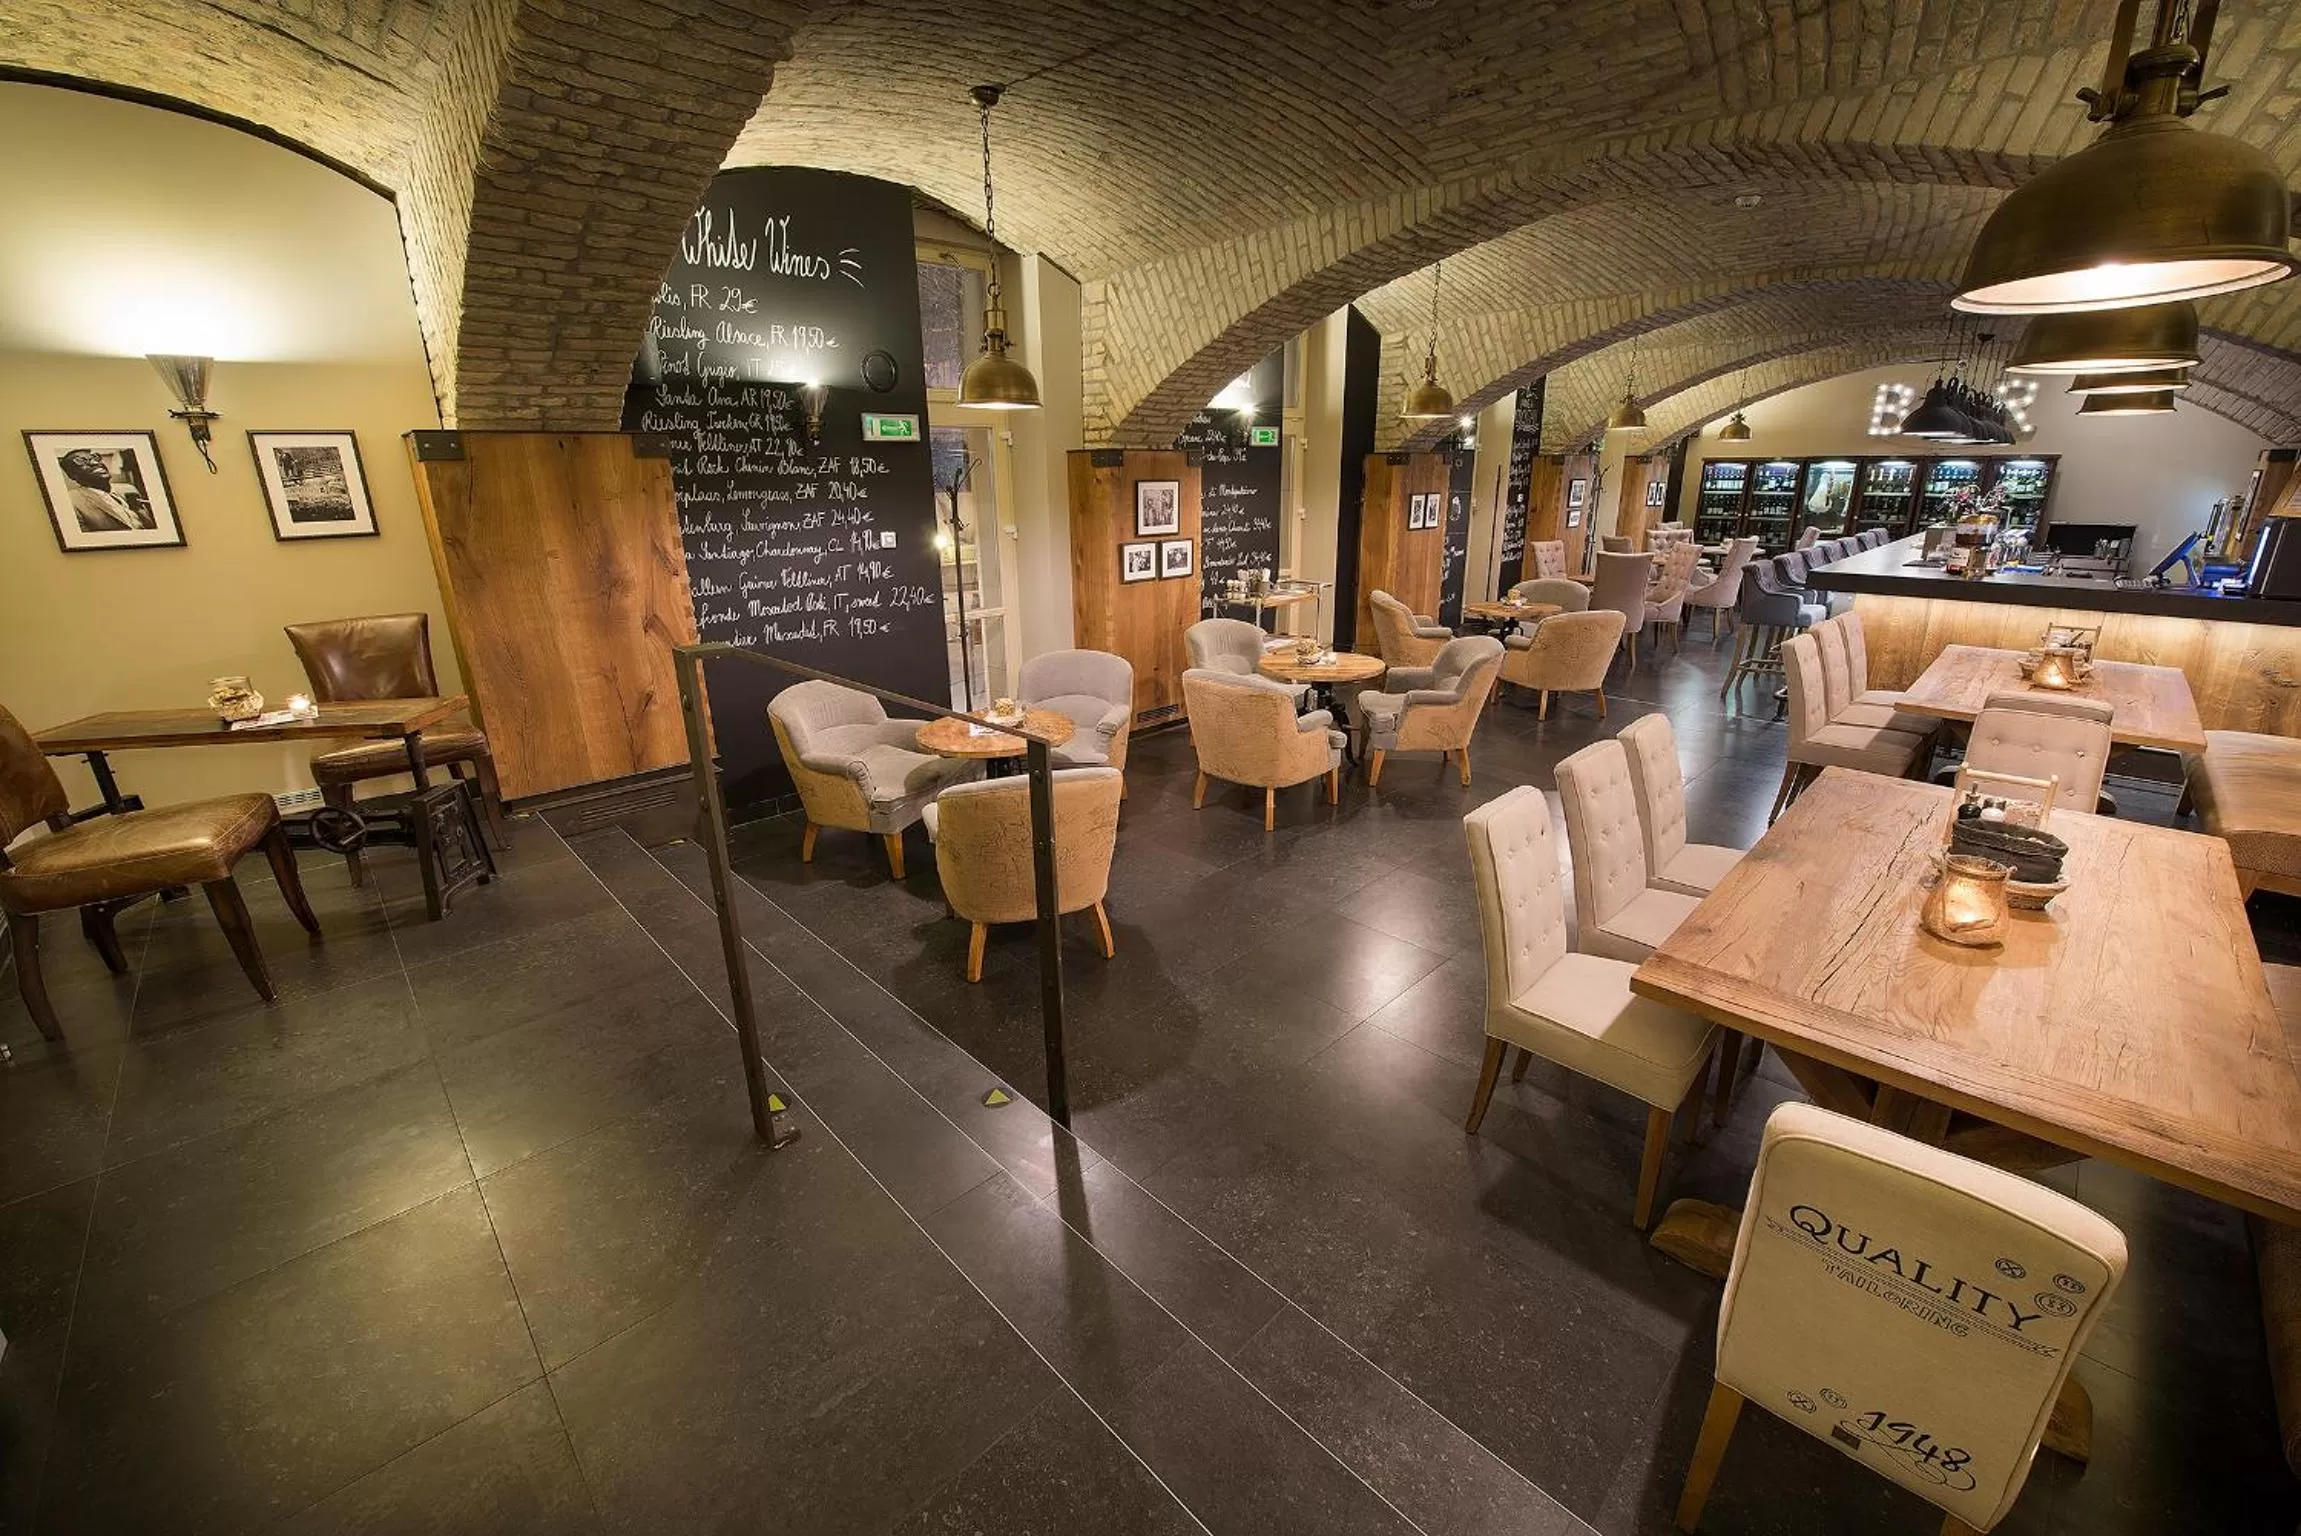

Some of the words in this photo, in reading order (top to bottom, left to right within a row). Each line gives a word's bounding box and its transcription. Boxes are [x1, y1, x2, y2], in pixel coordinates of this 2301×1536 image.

[682, 205, 757, 271] White
[765, 215, 830, 281] Wines
[691, 284, 711, 309] FR
[650, 316, 710, 350] Riesling
[771, 324, 788, 347] FR
[1867, 379, 2038, 437] BR
[1789, 1205, 2042, 1331] QUALITY
[1823, 1261, 1968, 1338] TAILORING
[1863, 1411, 1972, 1473] 1948
